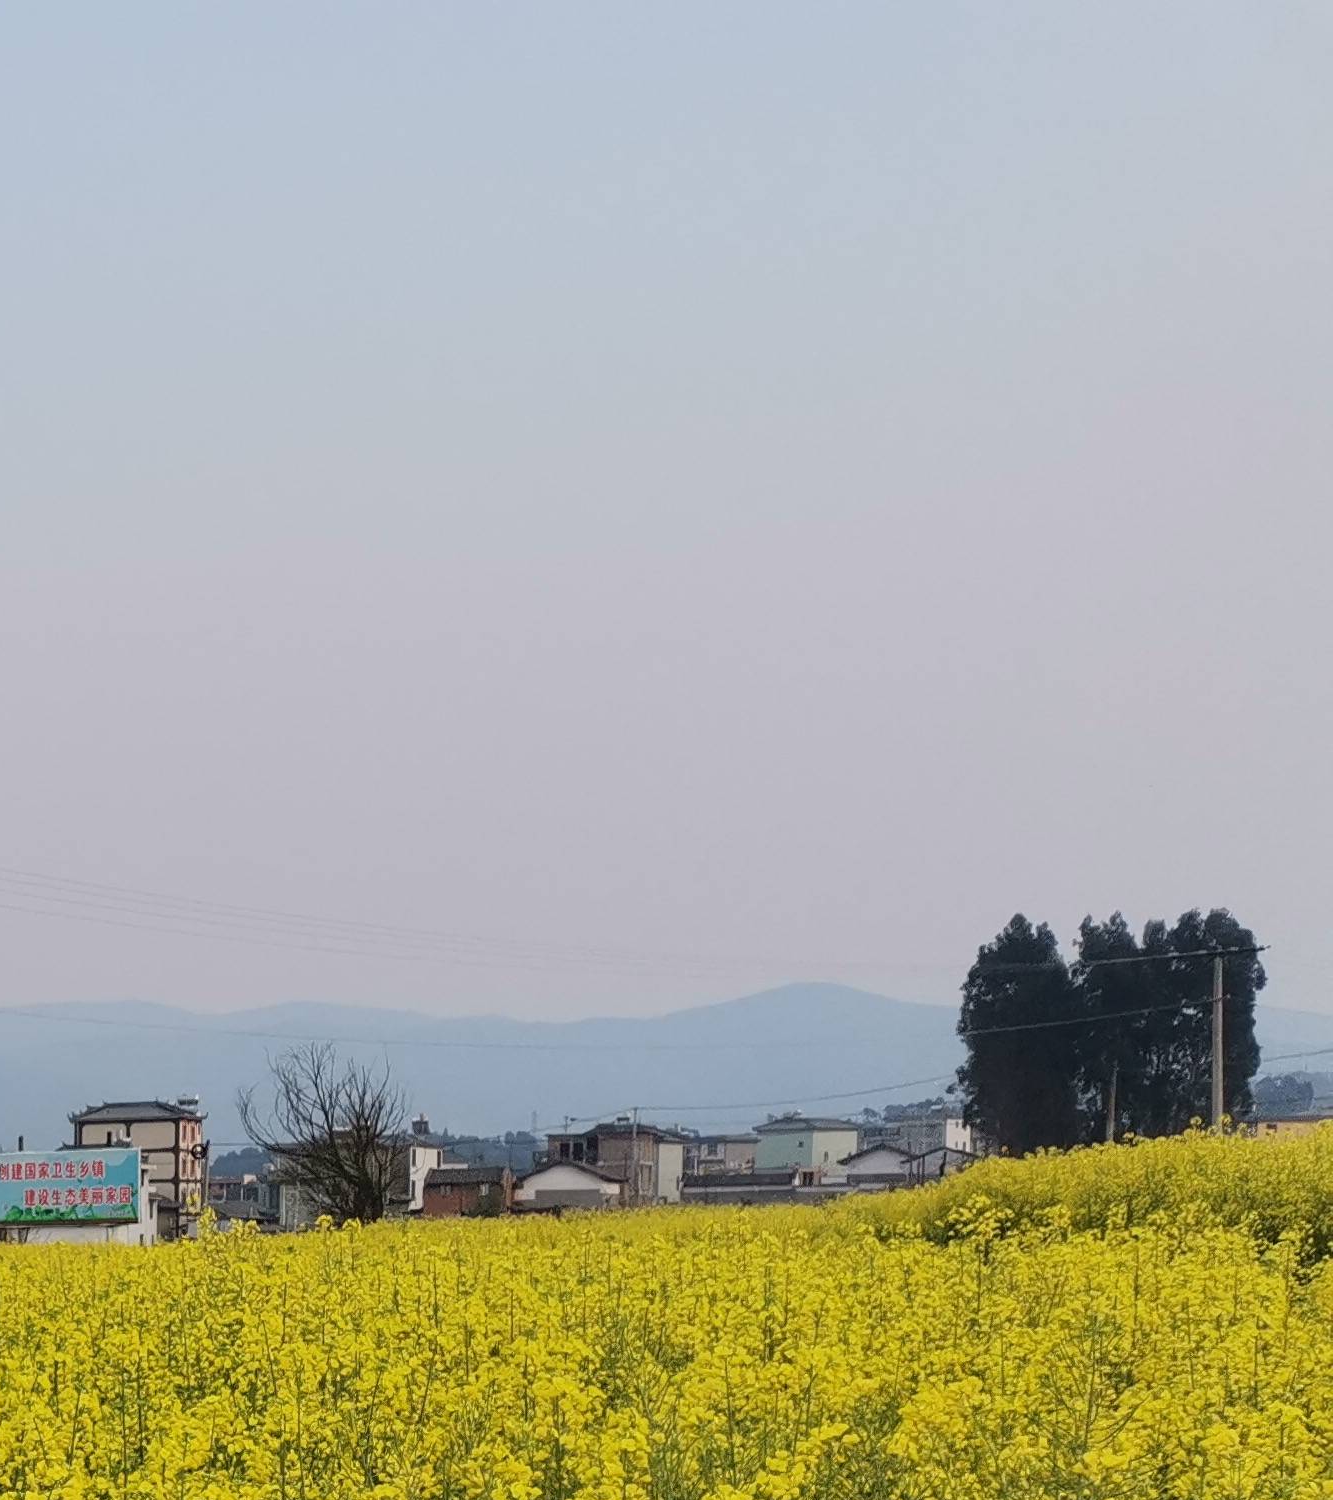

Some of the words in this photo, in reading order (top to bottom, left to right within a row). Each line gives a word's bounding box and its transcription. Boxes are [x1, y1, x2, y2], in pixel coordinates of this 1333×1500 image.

[24, 1185, 133, 1207] 建设生态美丽家园
